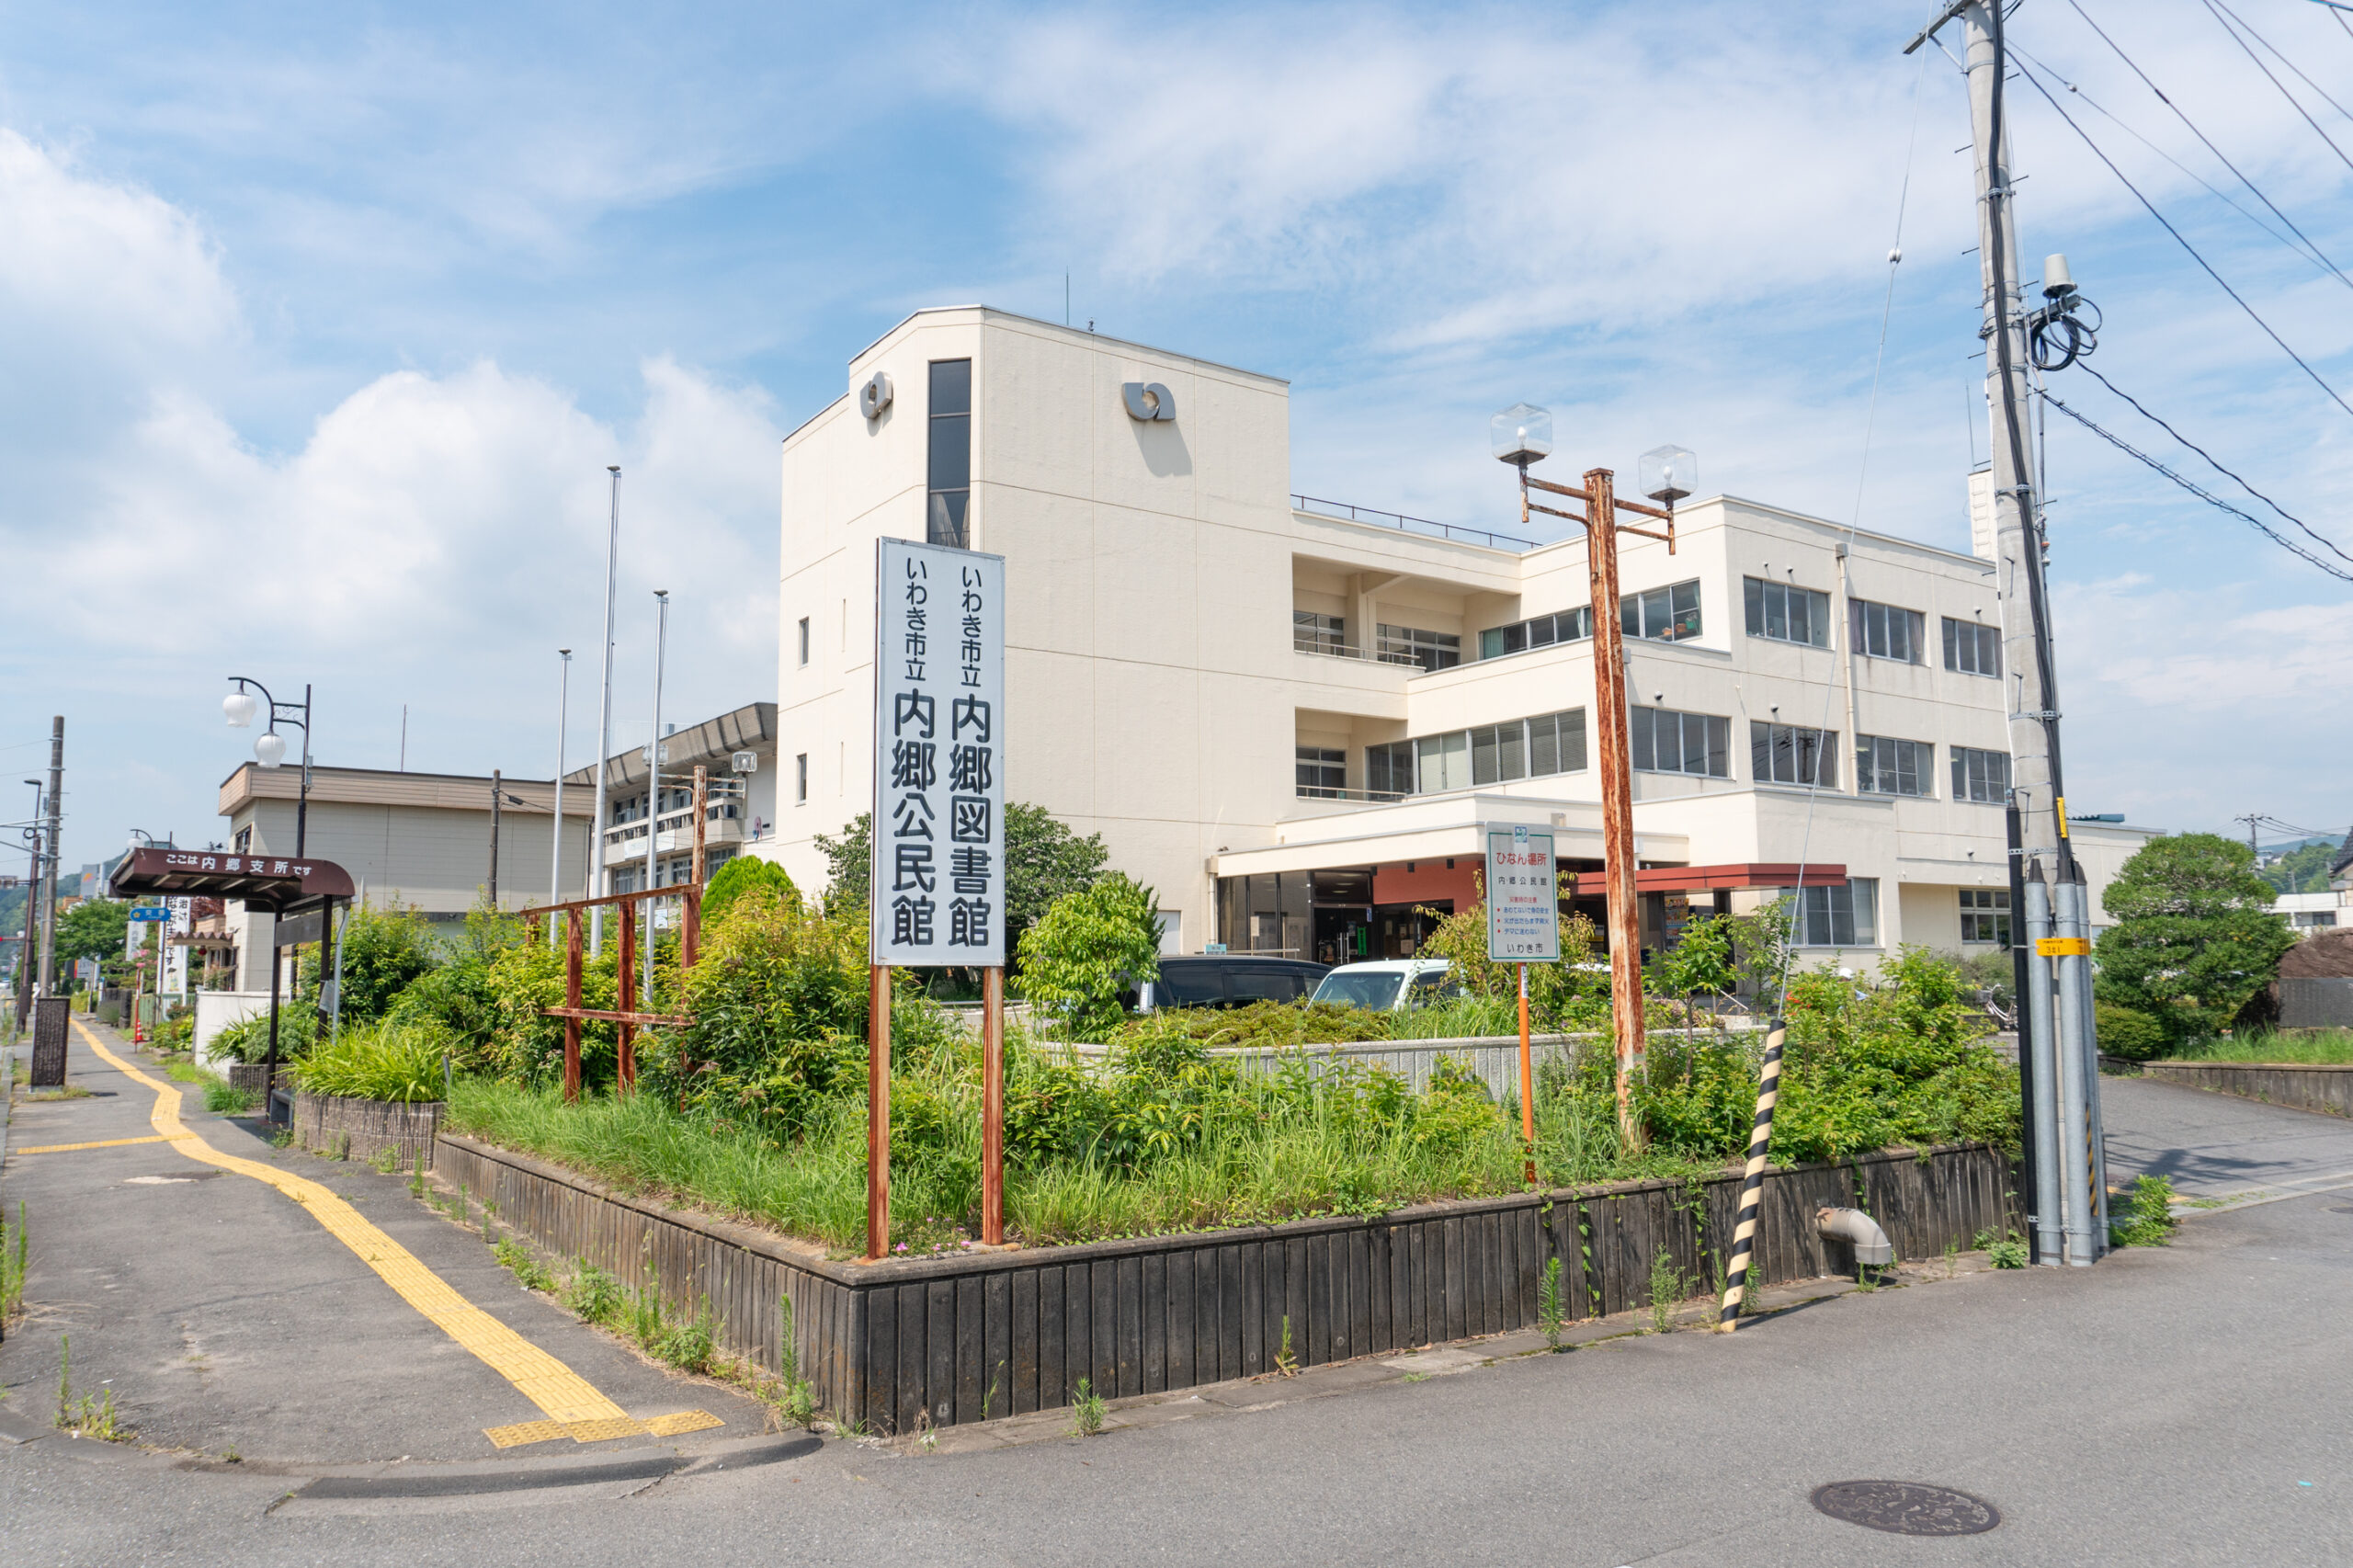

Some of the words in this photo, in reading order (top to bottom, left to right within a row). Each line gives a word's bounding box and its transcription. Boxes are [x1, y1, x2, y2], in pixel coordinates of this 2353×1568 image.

[1496, 852, 1547, 866] ひなん場所
[1498, 876, 1547, 886] 内郷公民館
[1506, 942, 1543, 954] いわき市
